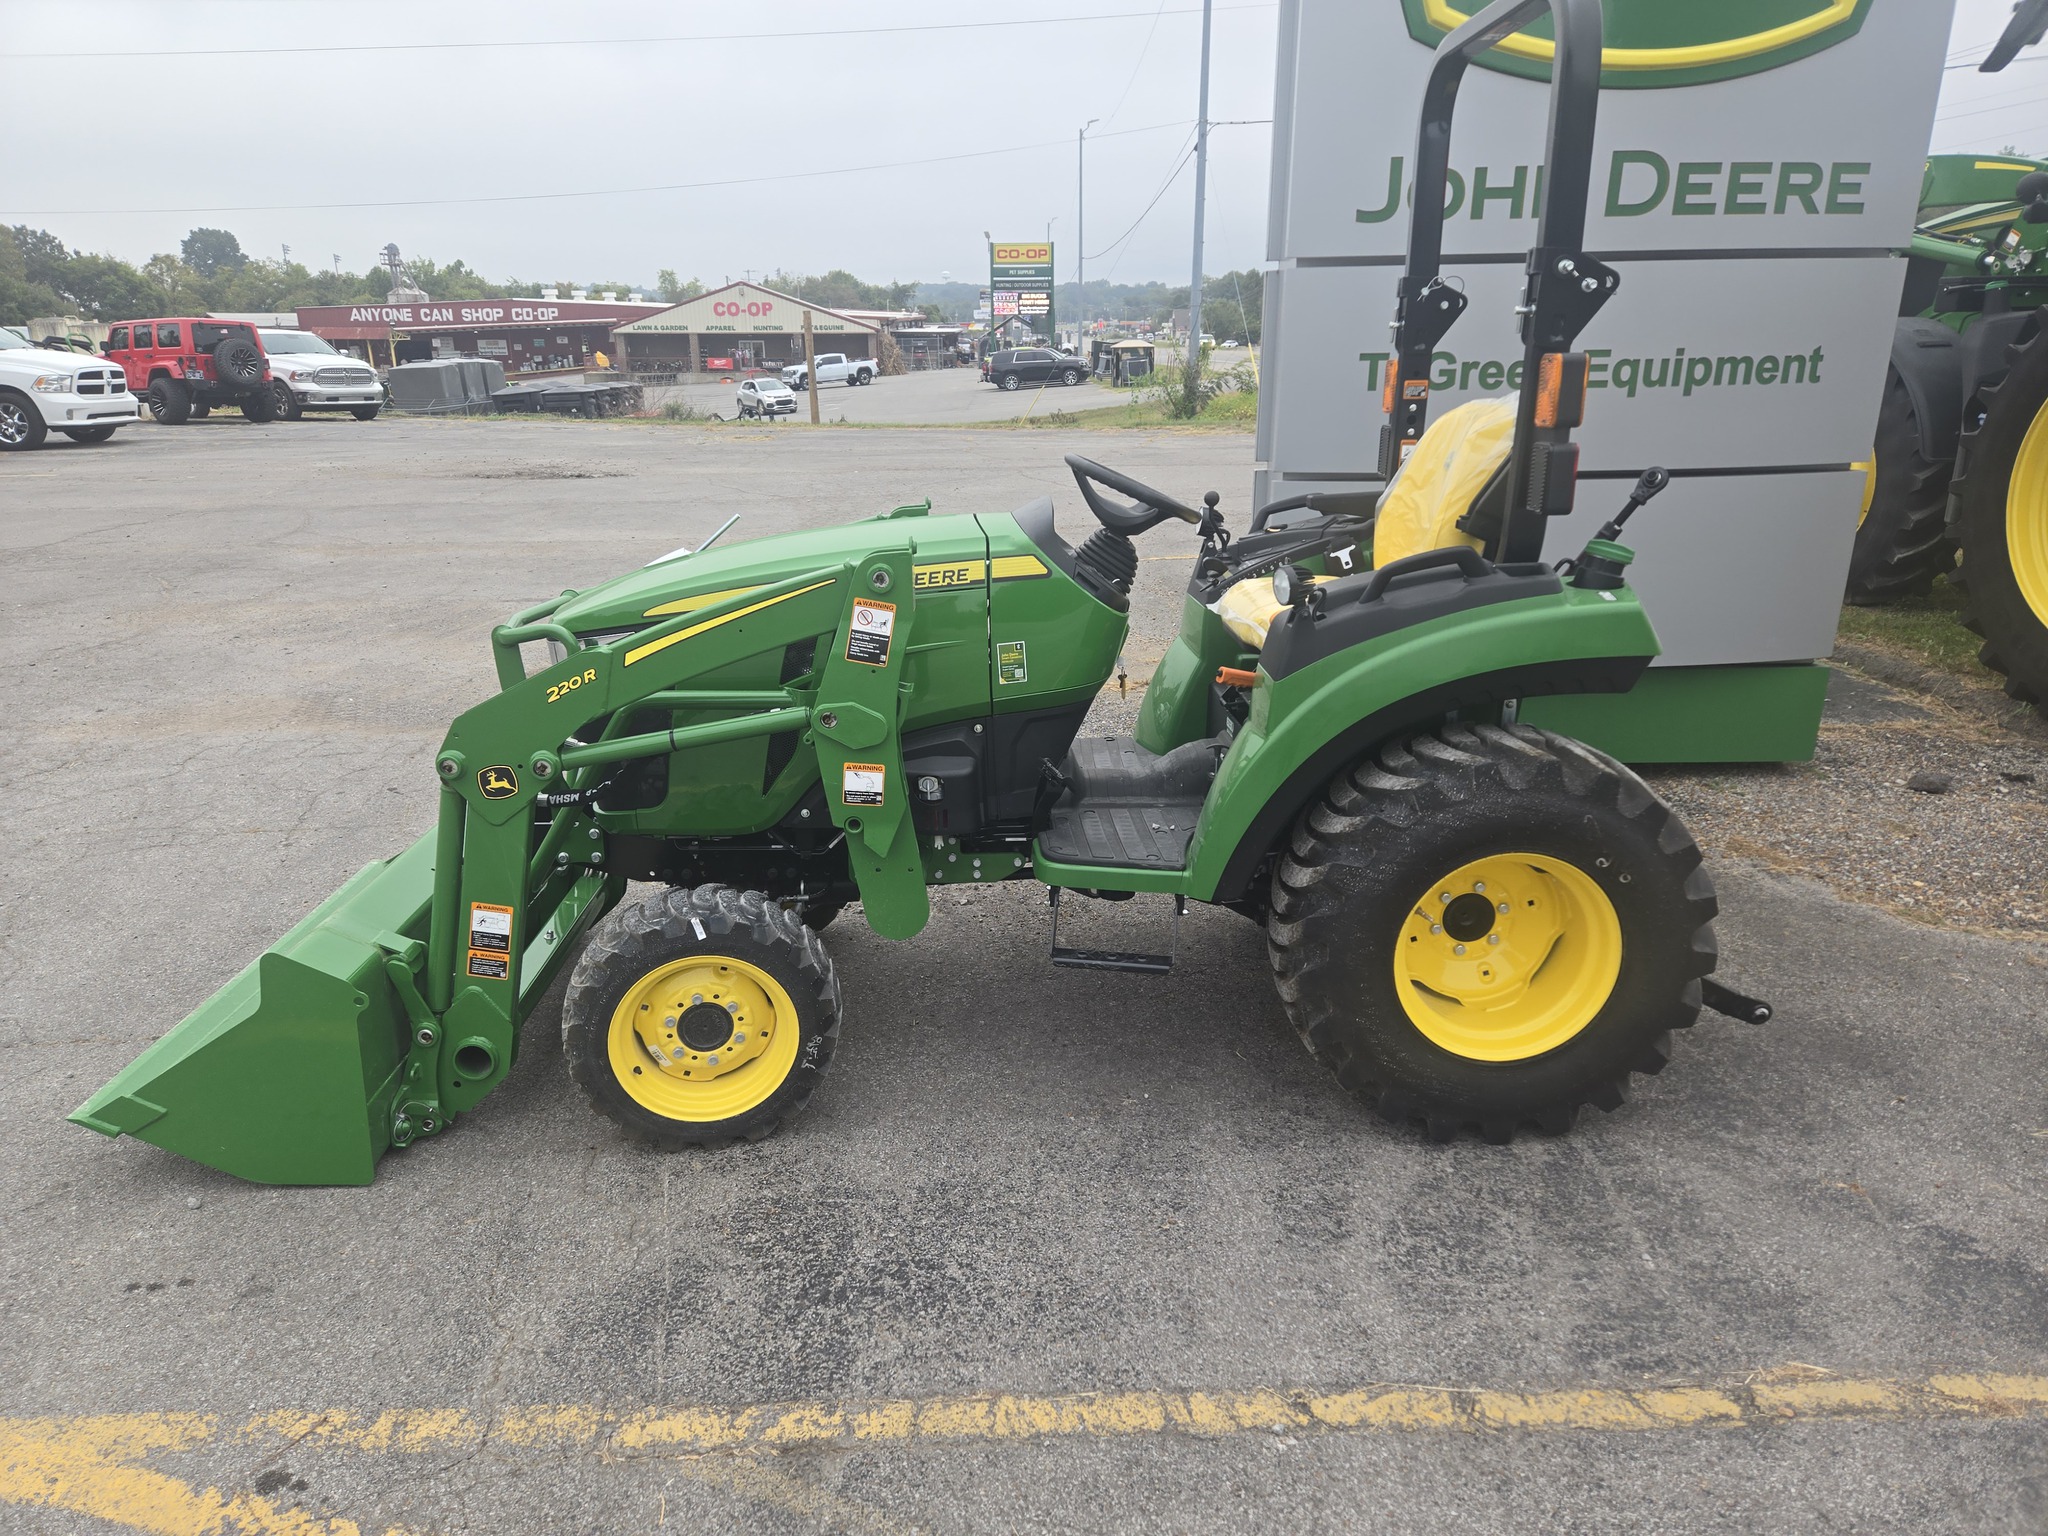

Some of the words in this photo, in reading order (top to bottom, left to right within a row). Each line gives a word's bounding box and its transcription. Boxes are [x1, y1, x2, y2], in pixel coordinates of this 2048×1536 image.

[1604, 149, 1871, 217] DEERE
[997, 249, 1048, 258] CO-OP
[350, 307, 413, 322] ANYONE
[420, 307, 453, 321] CAN
[461, 307, 503, 322] SHOP
[511, 307, 559, 321] CO-OP
[713, 301, 773, 317] CO-OP
[1429, 351, 1525, 392] Gree
[1583, 345, 1824, 398] Equipment
[862, 600, 894, 611] WARNING
[851, 764, 883, 772] WARNING
[548, 792, 580, 805] MSHA
[482, 904, 509, 913] WARNING
